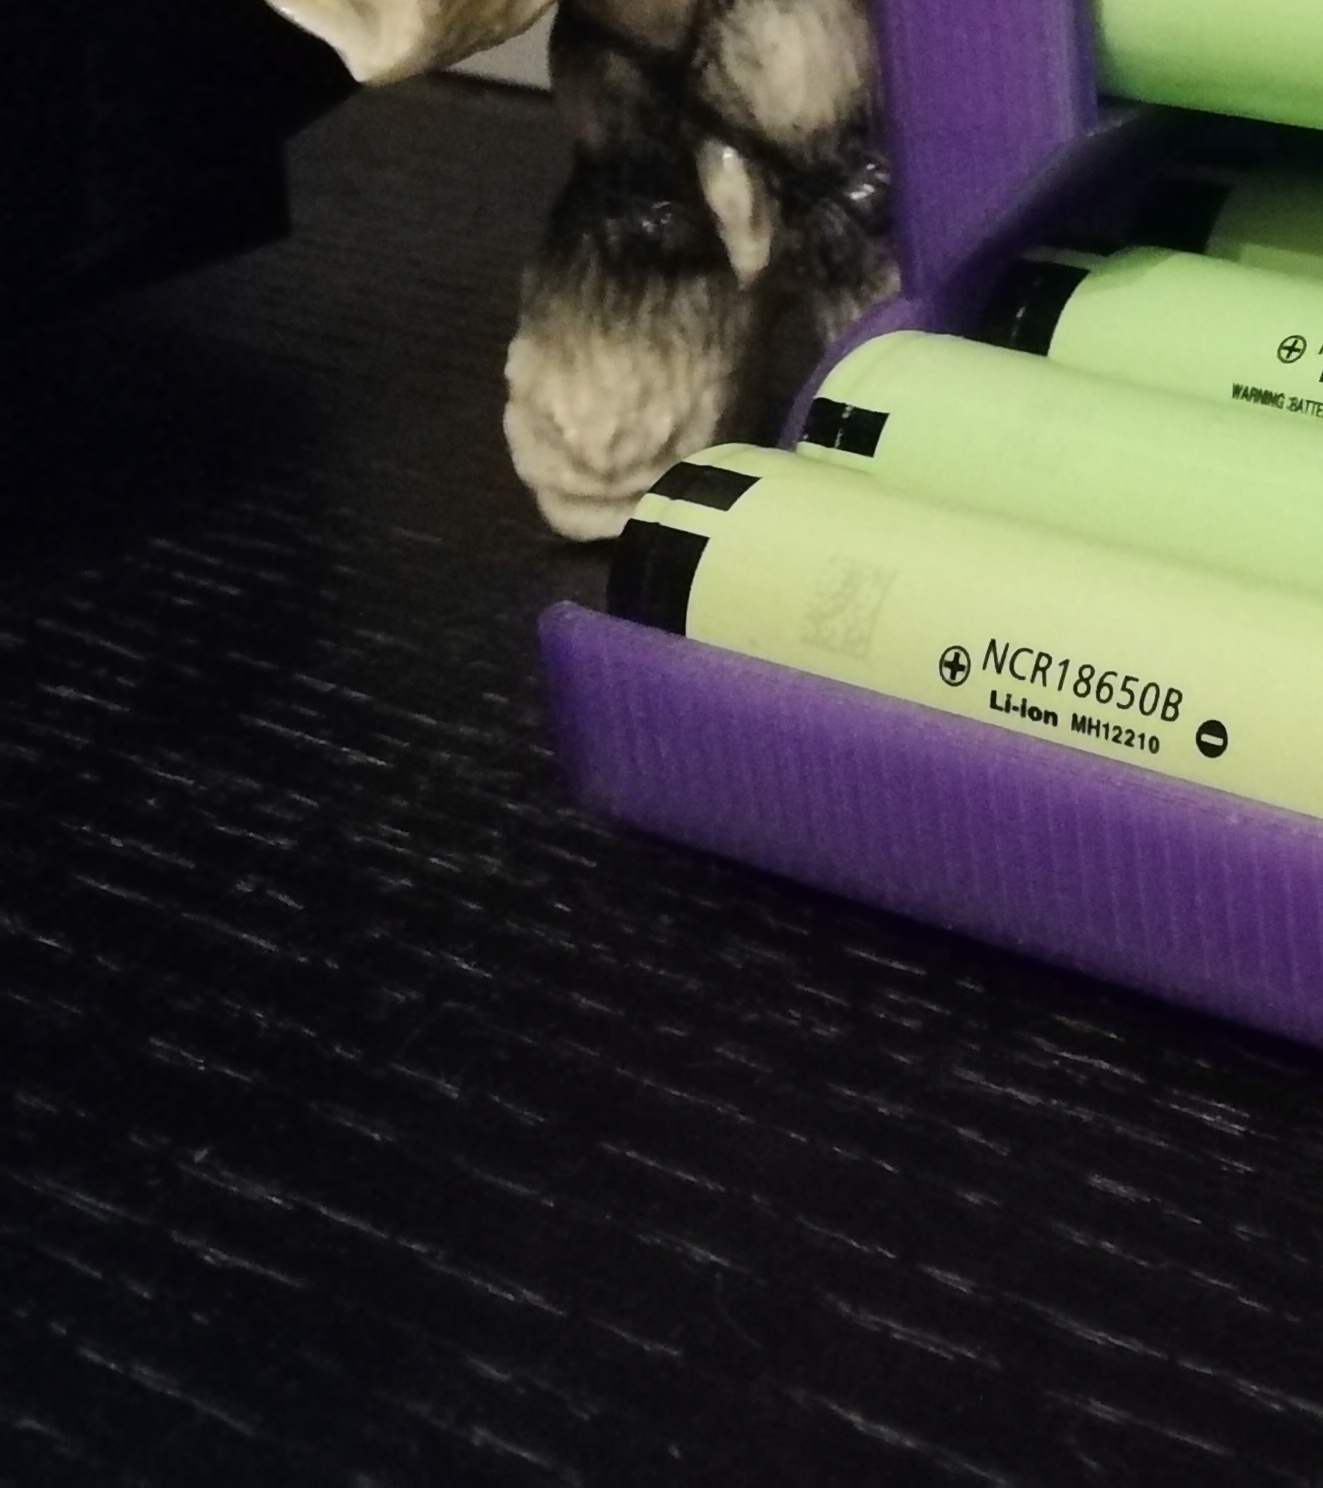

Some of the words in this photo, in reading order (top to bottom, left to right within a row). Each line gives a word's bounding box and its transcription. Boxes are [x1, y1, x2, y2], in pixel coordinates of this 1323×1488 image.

[982, 638, 1183, 722] NCR18650B
[989, 690, 1058, 727] Li-ion
[1071, 712, 1160, 754] MH12210
